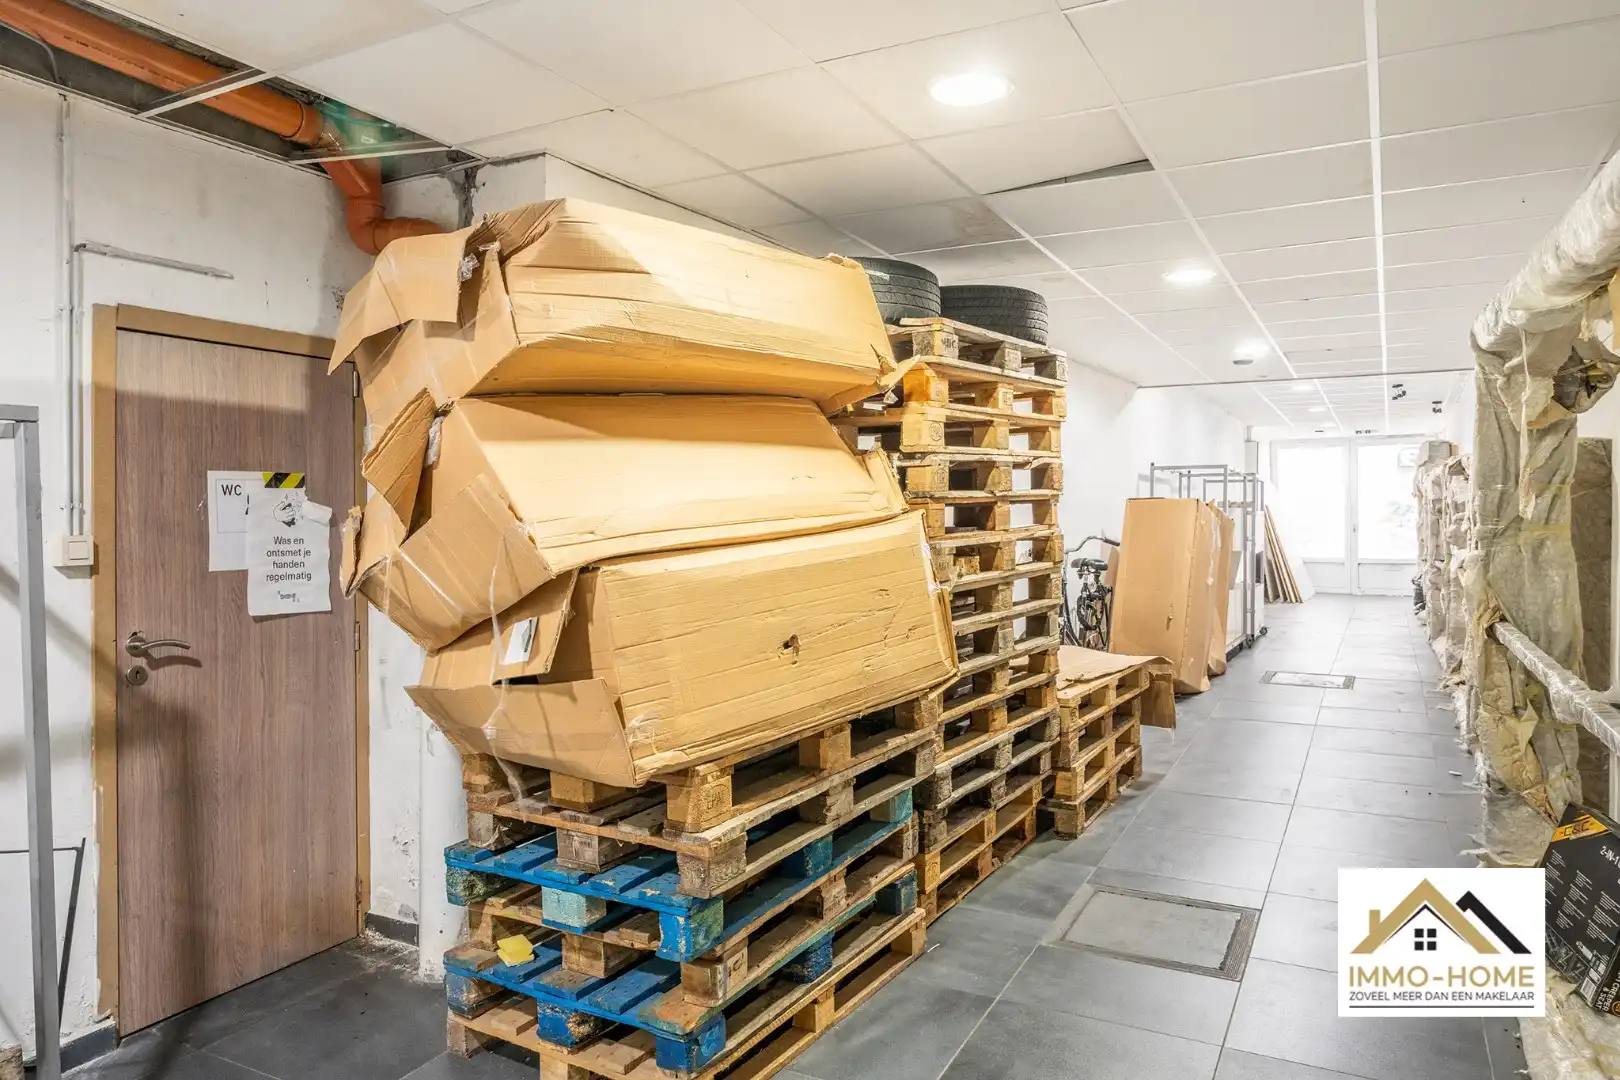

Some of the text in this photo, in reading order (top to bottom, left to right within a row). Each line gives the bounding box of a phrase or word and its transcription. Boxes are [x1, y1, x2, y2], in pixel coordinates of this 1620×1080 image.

[221, 484, 242, 496] WC
[273, 536, 291, 545] Was
[266, 549, 311, 558] ontsmet je
[272, 560, 305, 569] handen
[266, 572, 312, 583] regelmatig
[1602, 982, 1620, 1012] CREEPER
